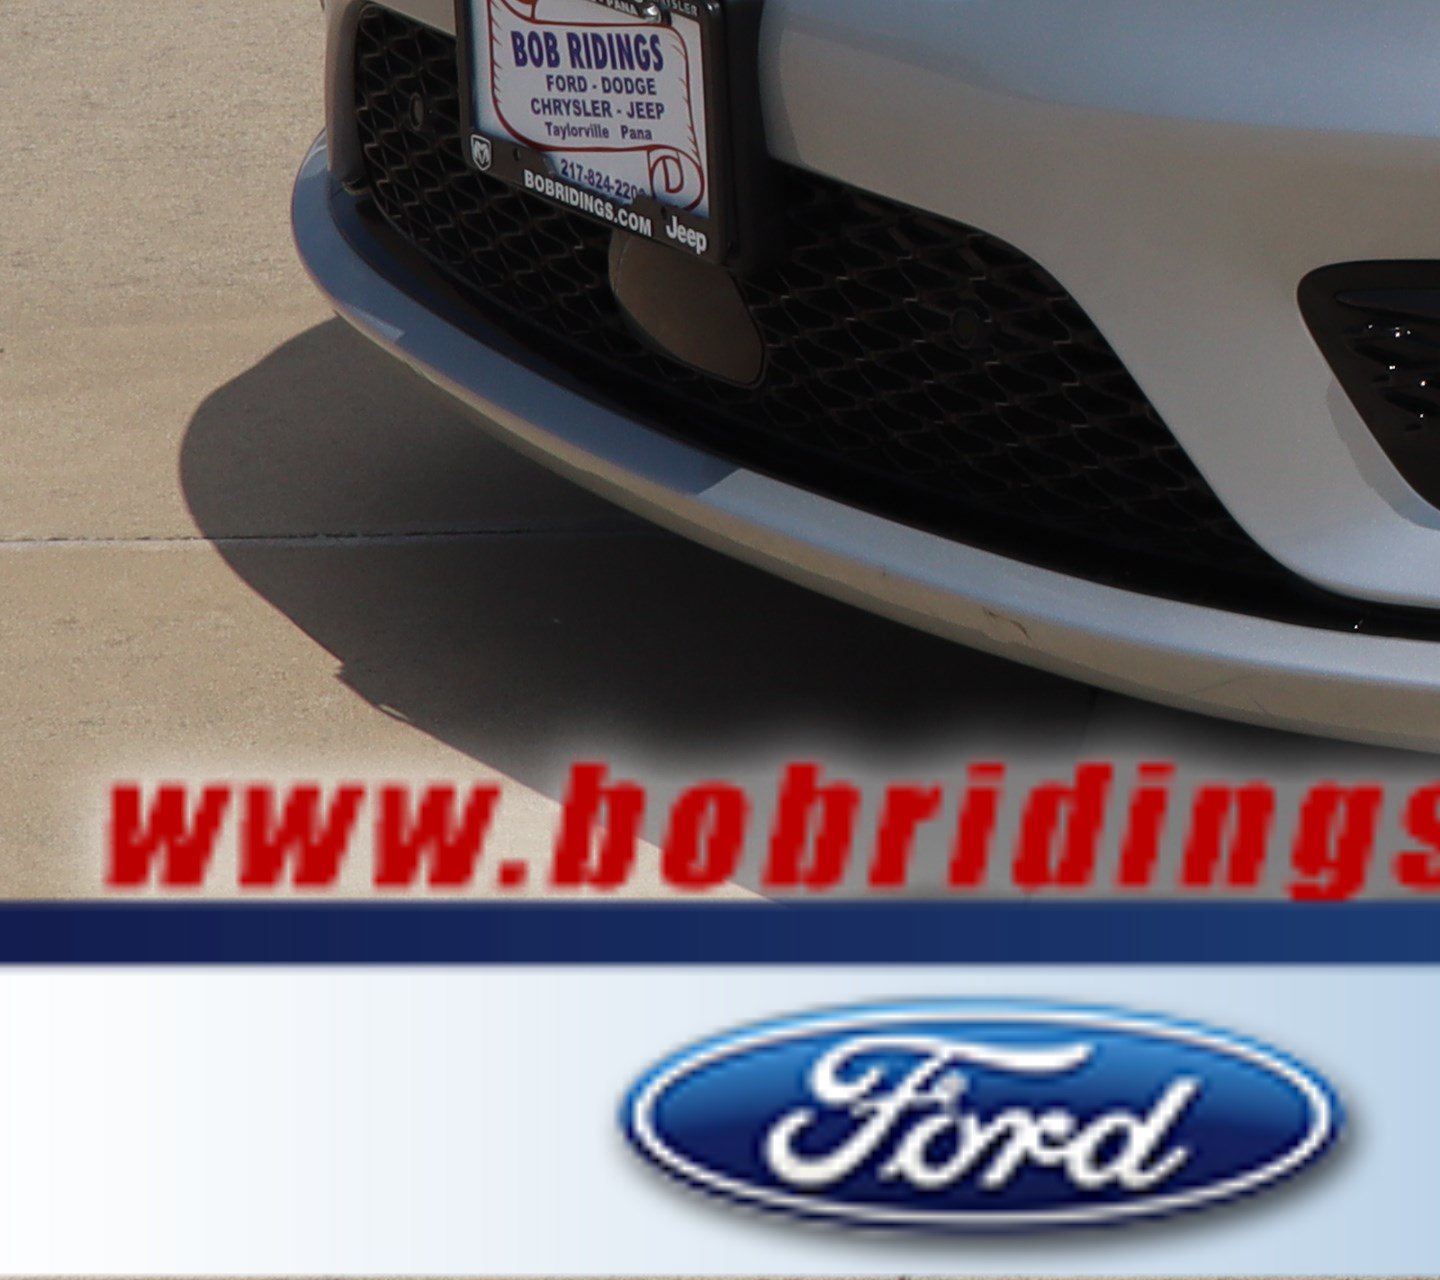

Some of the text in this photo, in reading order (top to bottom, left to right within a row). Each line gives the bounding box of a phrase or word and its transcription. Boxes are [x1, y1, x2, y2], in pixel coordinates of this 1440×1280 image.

[510, 30, 664, 73] BOB RIDINGS
[545, 74, 588, 93] FORD
[601, 76, 658, 96] DODGE
[530, 98, 613, 119] CHRYSLER
[626, 102, 666, 120] JEEP
[544, 121, 653, 141] Taylorville Pana
[523, 168, 652, 238] BOBRIDINGS.COM
[665, 215, 708, 255] Jeep
